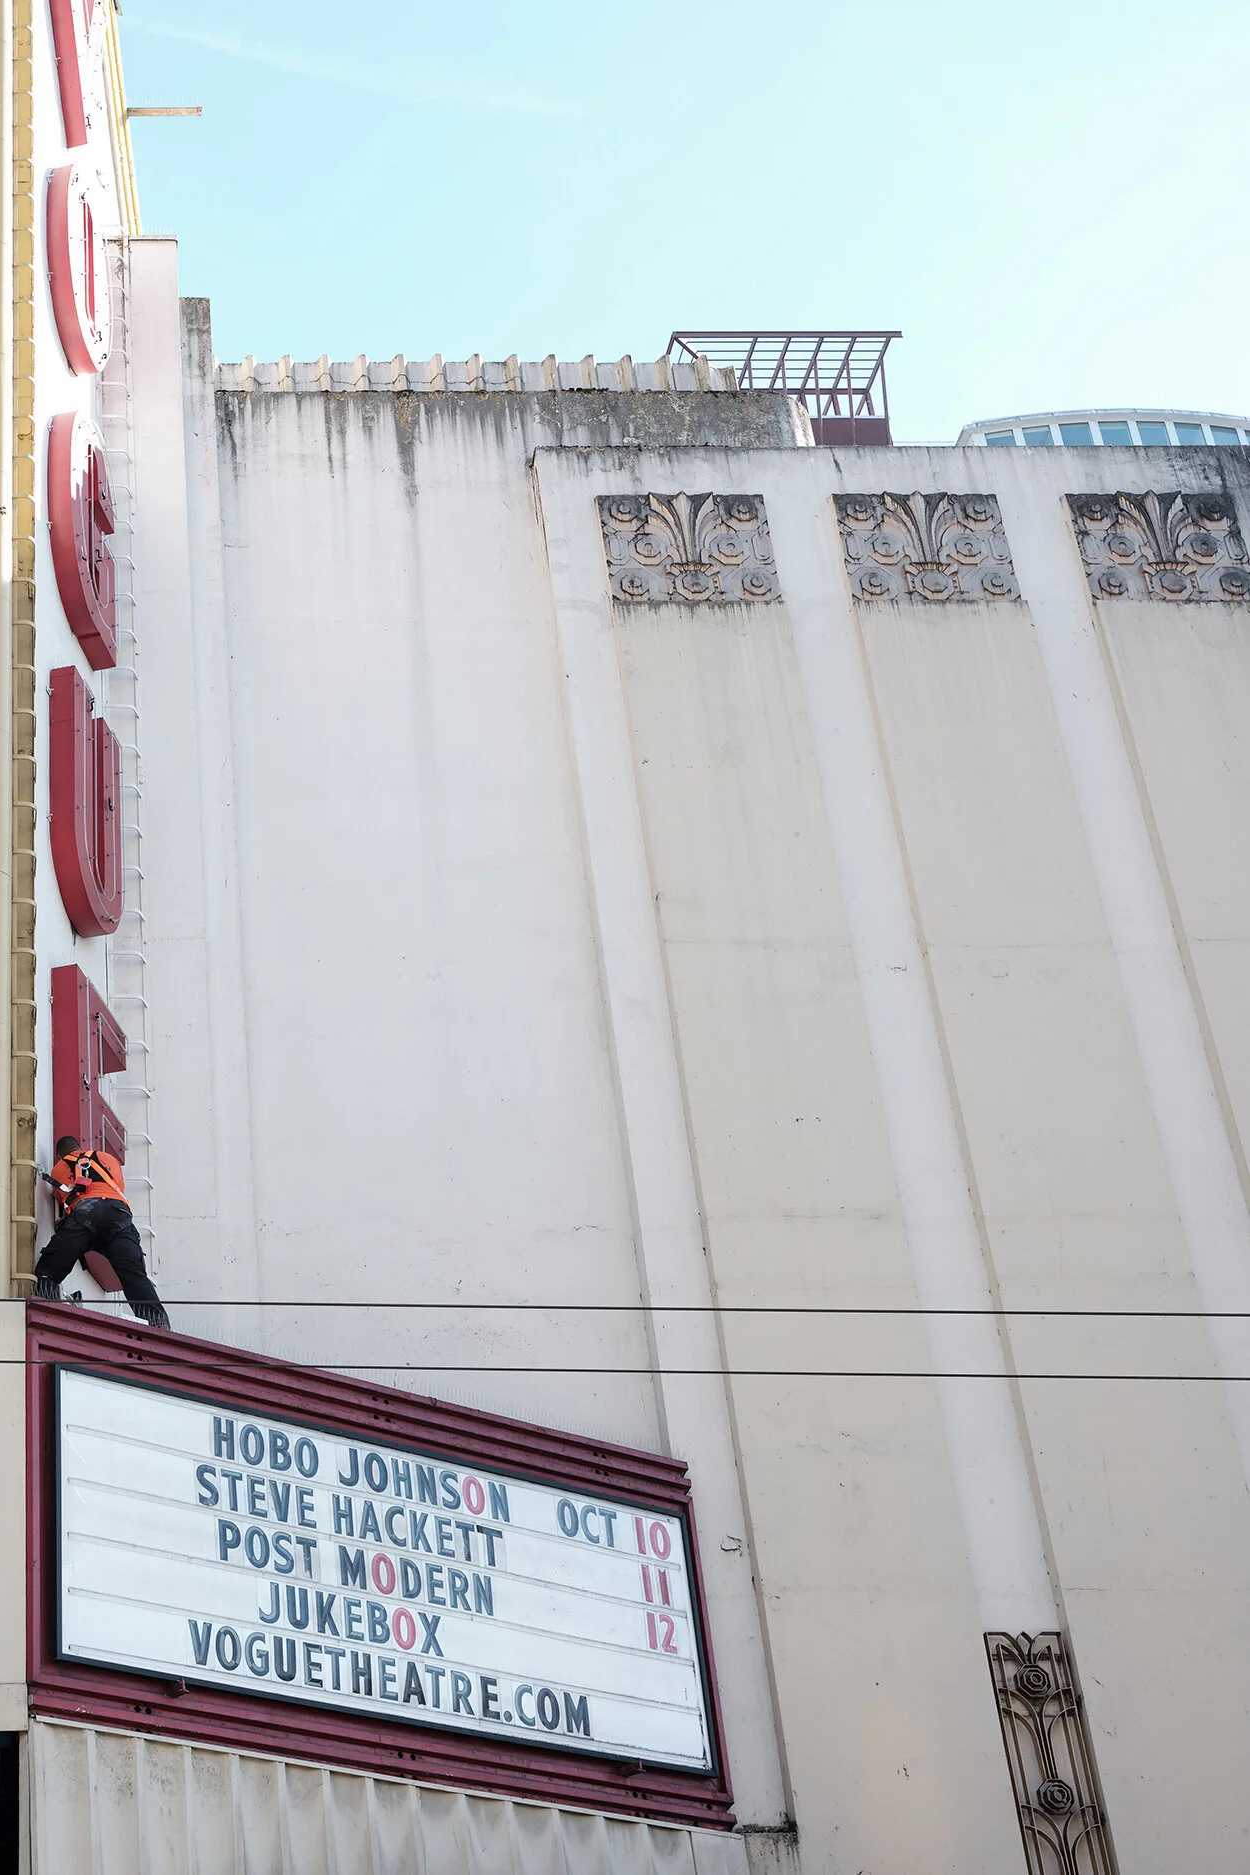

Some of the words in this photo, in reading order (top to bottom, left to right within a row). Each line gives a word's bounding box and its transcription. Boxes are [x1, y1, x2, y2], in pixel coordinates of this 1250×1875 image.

[196, 1464, 317, 1529] STEVE
[332, 1493, 503, 1567] HACKETT
[641, 1564, 670, 1606] 11
[213, 1416, 319, 1478] HOBO
[339, 1448, 510, 1522] JOHNSON
[557, 1498, 617, 1548] OCT
[635, 1516, 671, 1560] 10
[218, 1519, 317, 1579] POST
[338, 1545, 494, 1617] MODERN
[646, 1611, 678, 1654] 12
[258, 1582, 444, 1657] JUKEBOX
[188, 1619, 591, 1737] VOGUETHEATRE.COM
